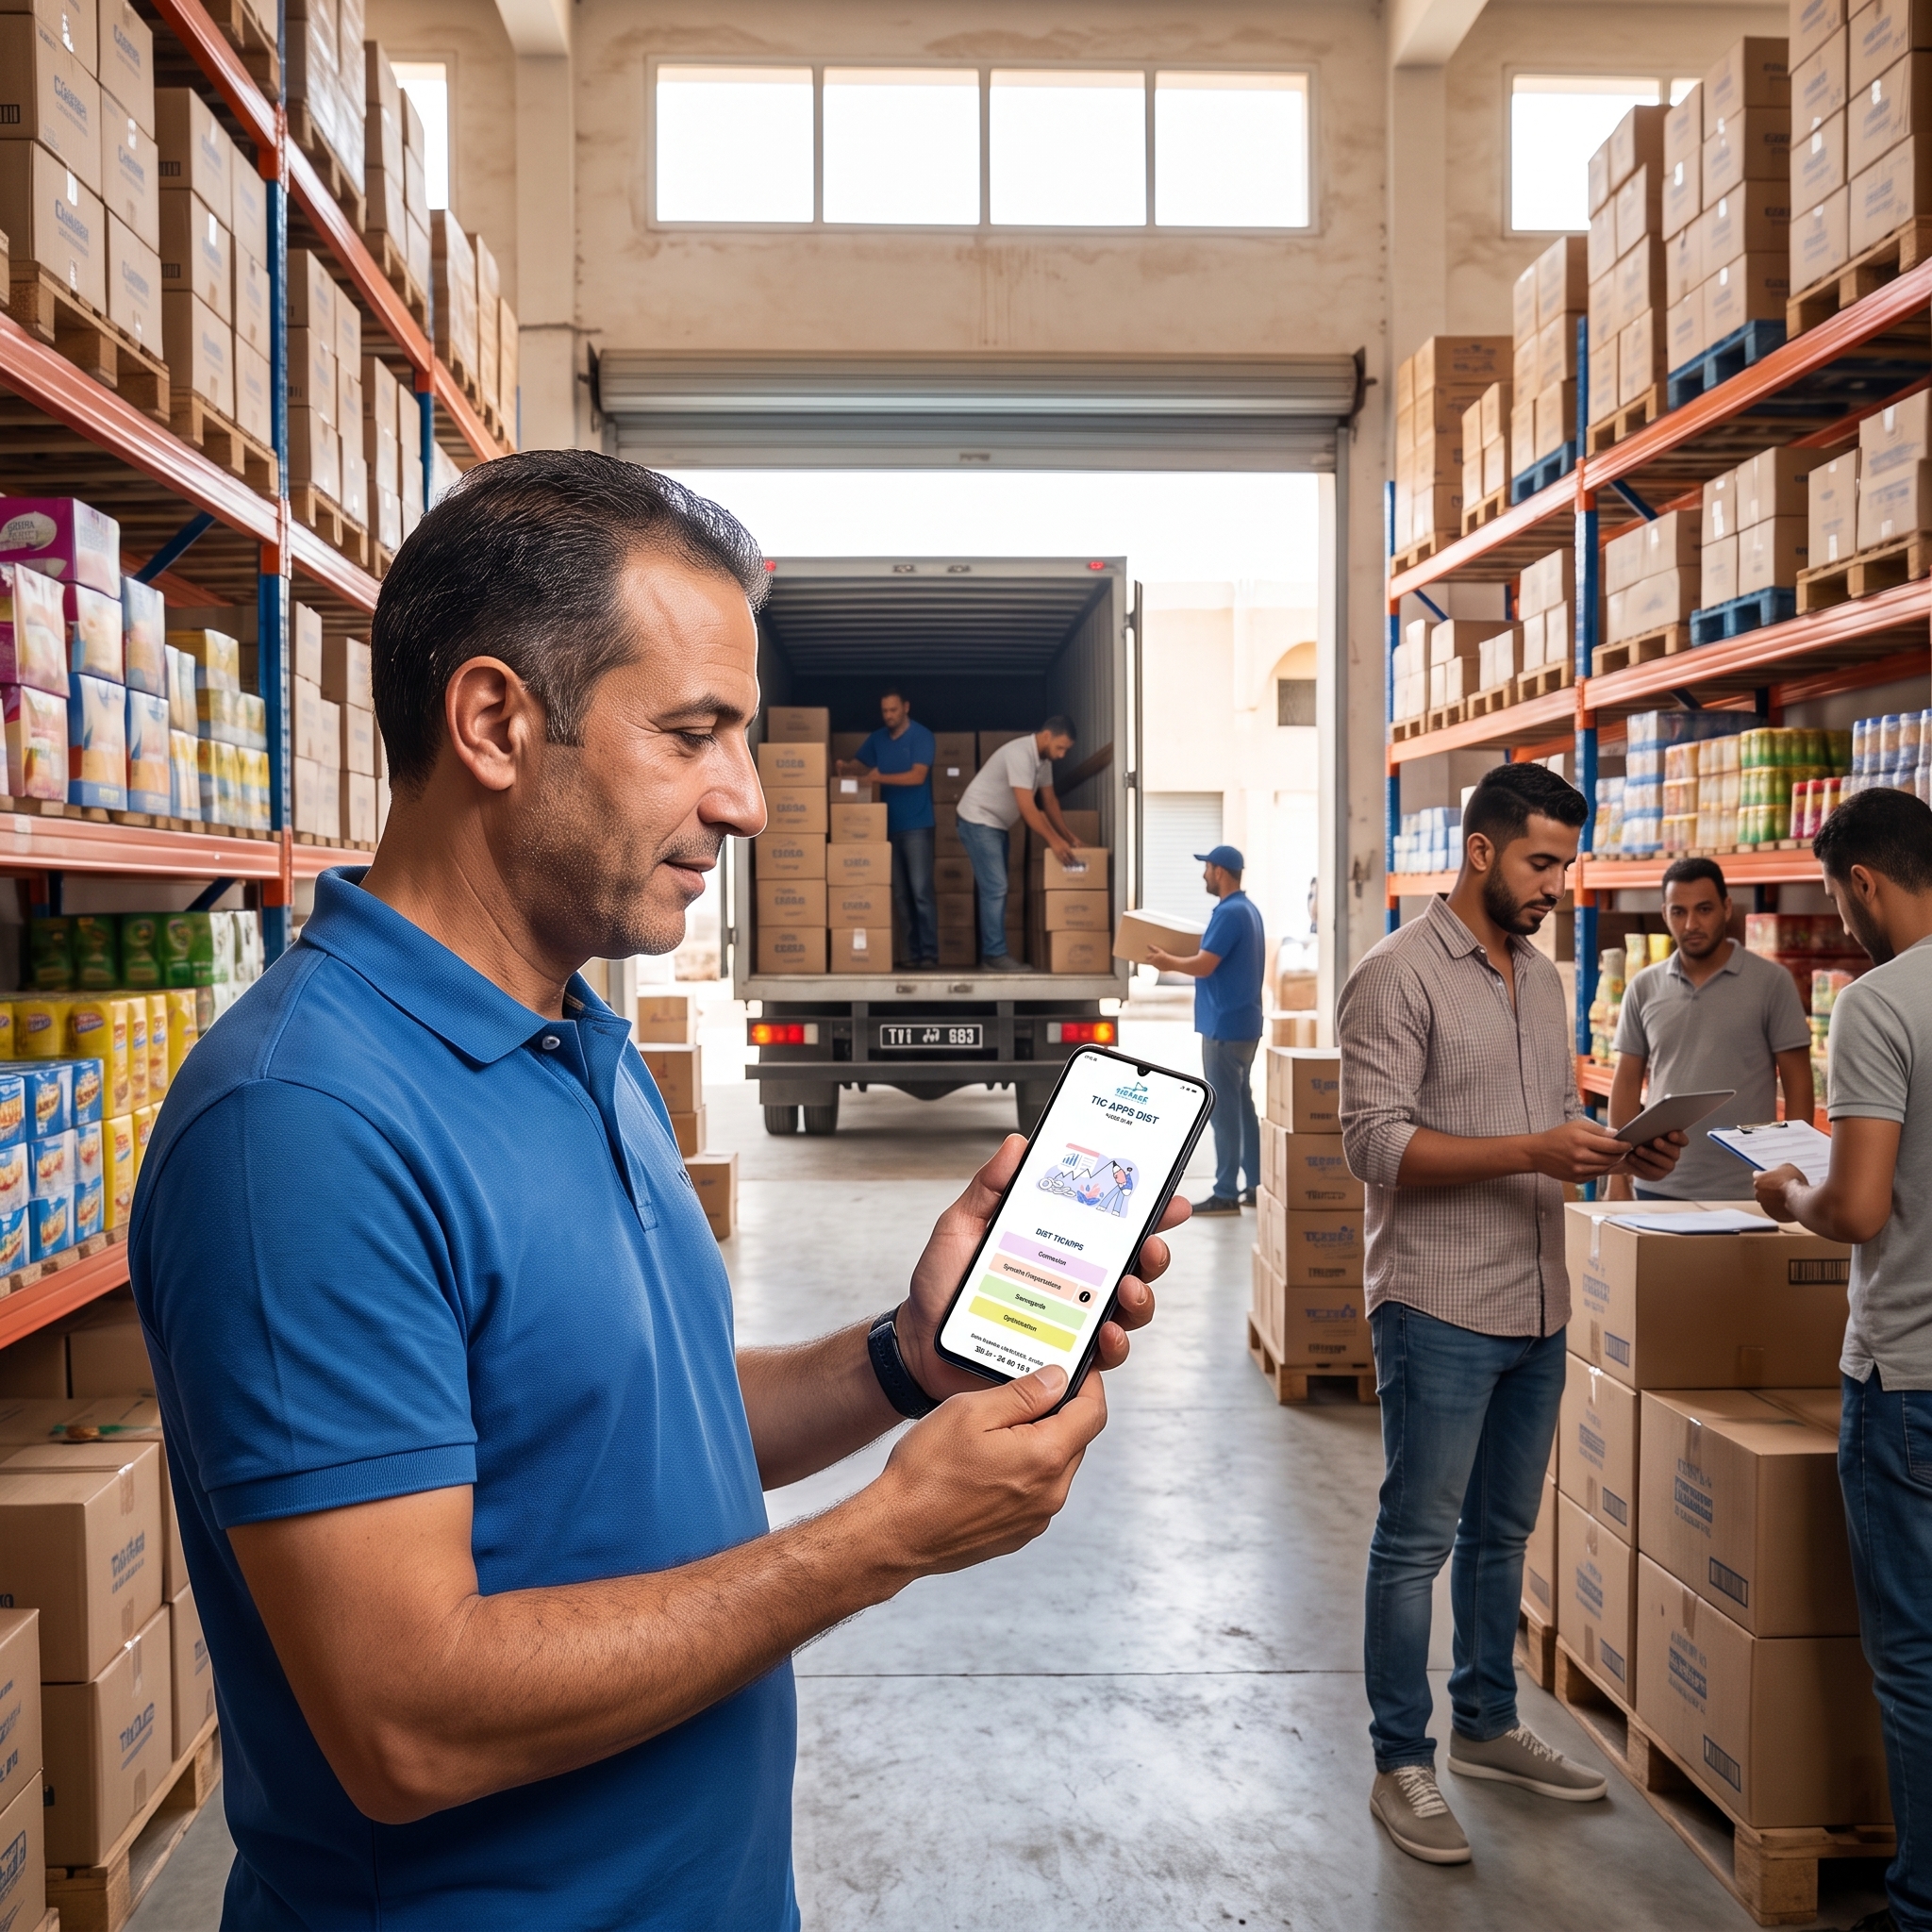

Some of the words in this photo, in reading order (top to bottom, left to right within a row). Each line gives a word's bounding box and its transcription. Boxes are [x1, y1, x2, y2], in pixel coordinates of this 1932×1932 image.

[1091, 1094, 1108, 1108] TIC
[1108, 1102, 1136, 1117] APPS
[1135, 1110, 1160, 1125] DIST
